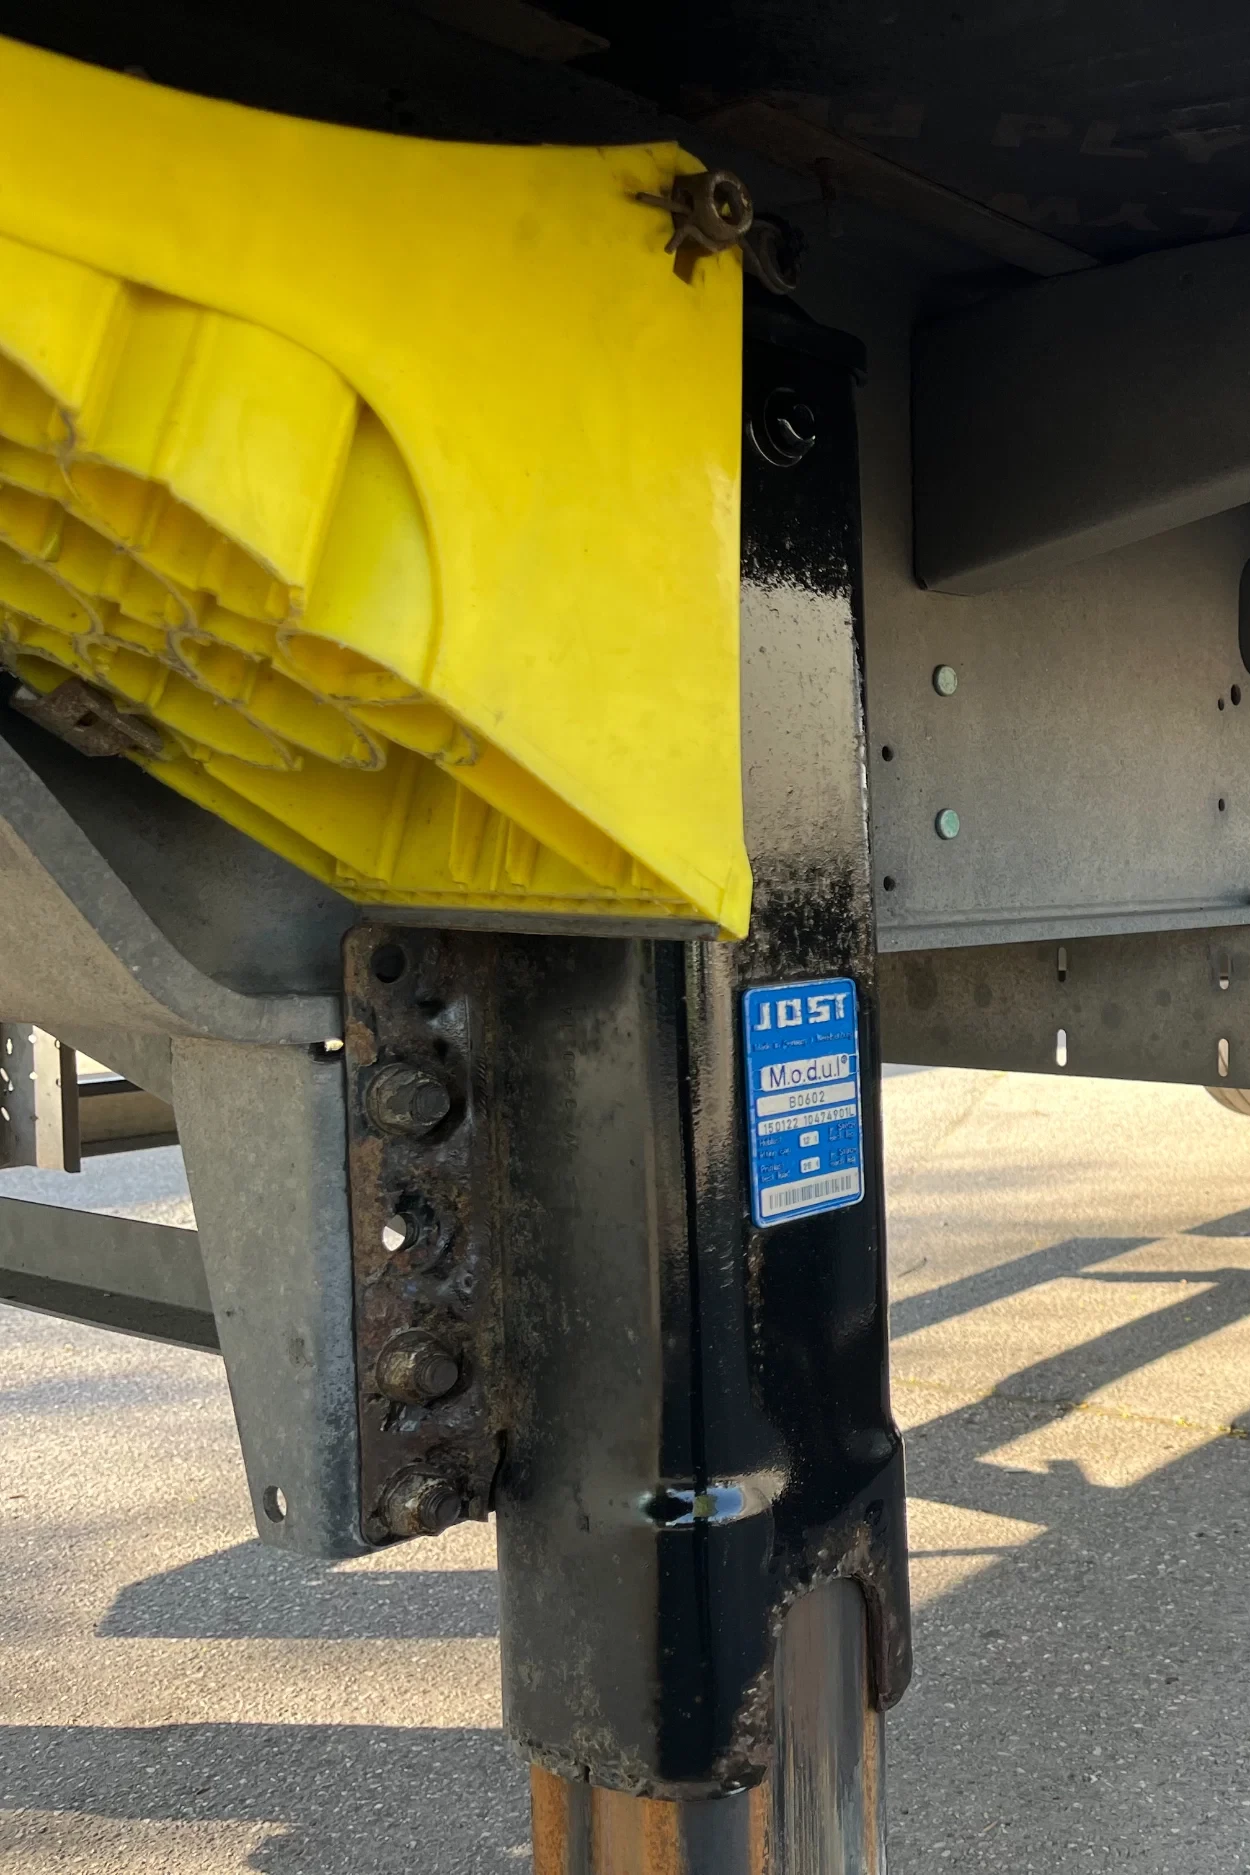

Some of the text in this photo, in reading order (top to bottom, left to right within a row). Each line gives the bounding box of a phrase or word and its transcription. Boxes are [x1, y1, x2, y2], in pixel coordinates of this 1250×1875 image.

[753, 992, 851, 1031] JOST
[789, 1090, 825, 1109] B0602
[763, 1117, 799, 1134] 150122
